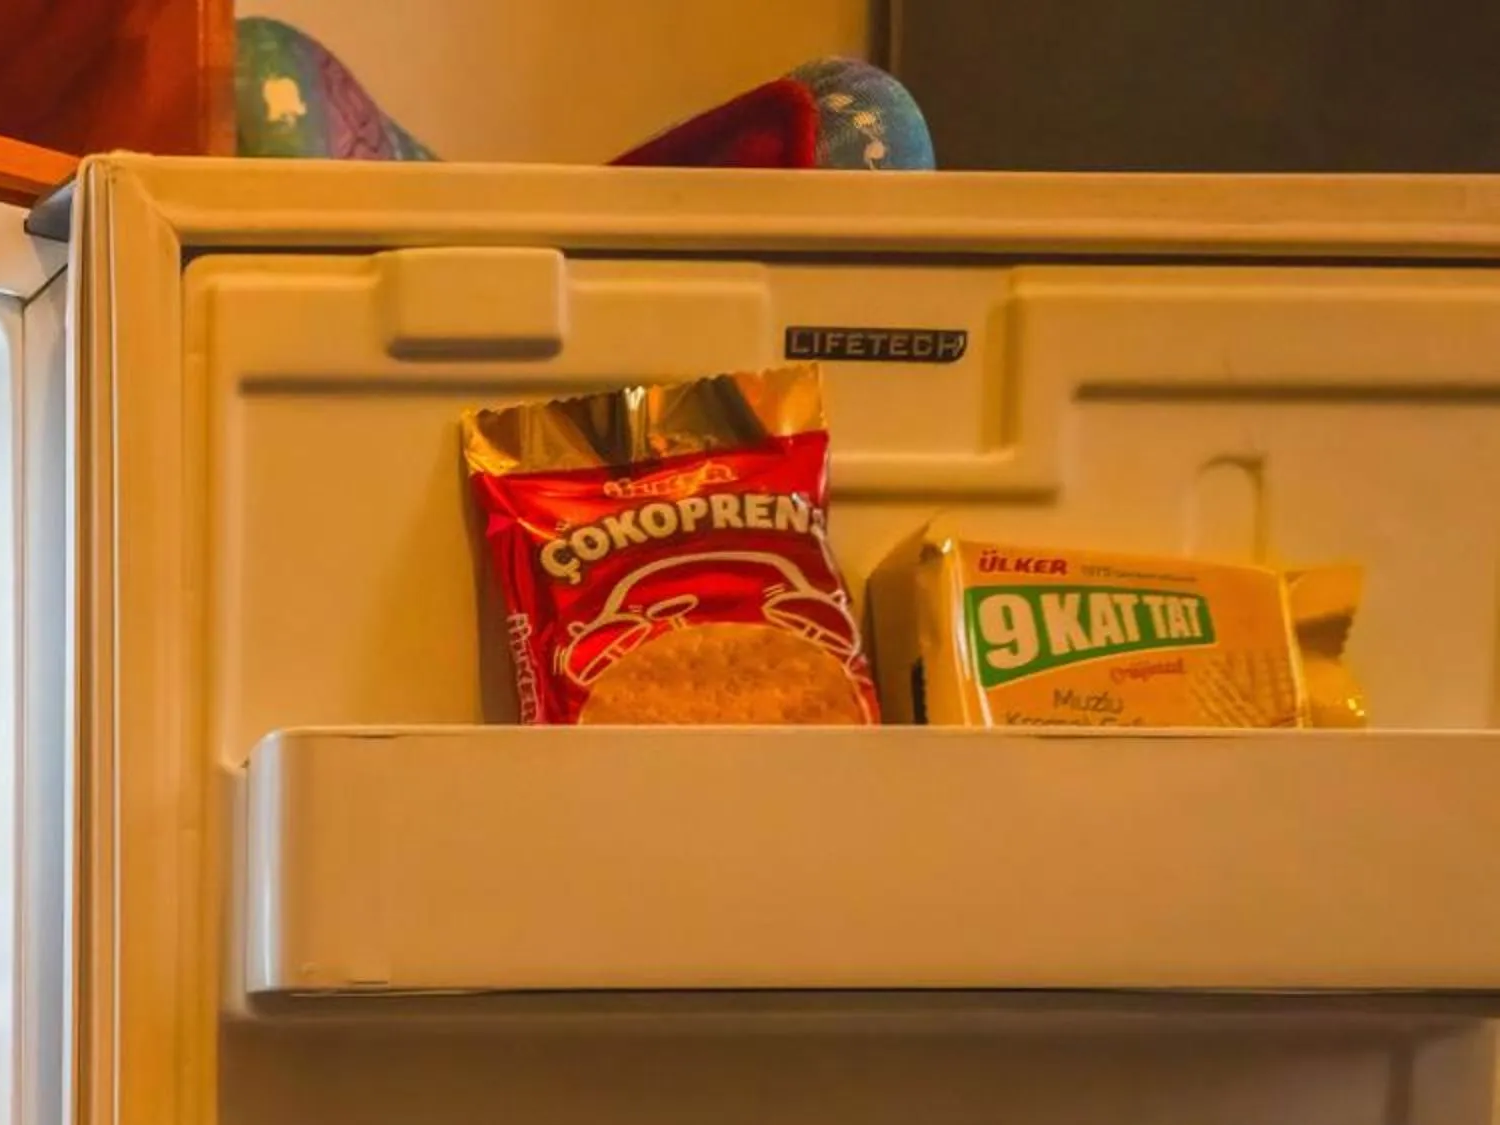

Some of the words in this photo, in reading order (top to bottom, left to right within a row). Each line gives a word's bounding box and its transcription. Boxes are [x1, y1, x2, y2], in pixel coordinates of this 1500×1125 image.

[790, 331, 965, 357] LIFETECH
[978, 549, 1069, 577] ÜLKER
[978, 593, 1039, 670] 9
[1039, 592, 1141, 657] KAT
[1141, 595, 1203, 640] TAT
